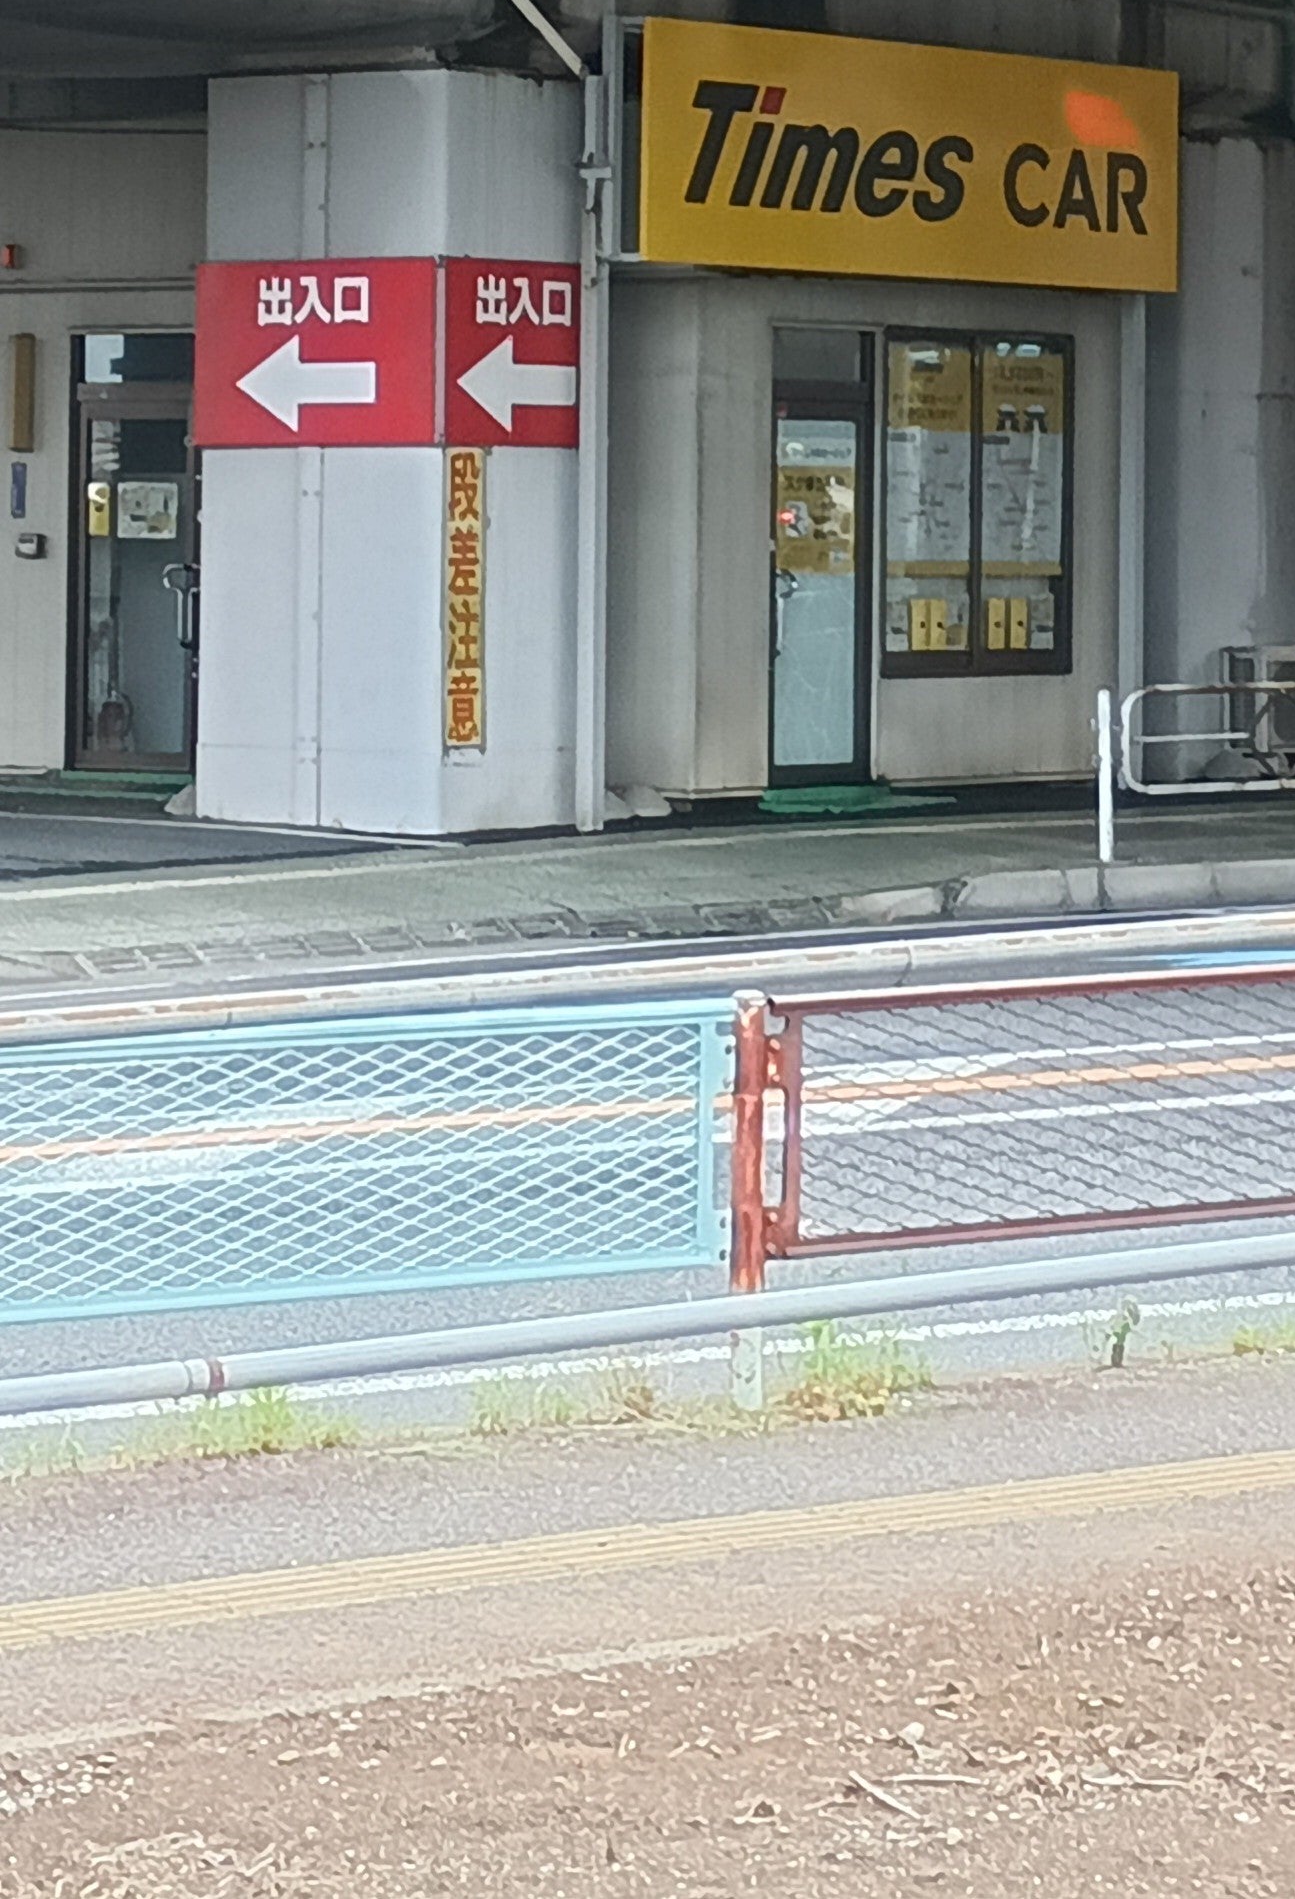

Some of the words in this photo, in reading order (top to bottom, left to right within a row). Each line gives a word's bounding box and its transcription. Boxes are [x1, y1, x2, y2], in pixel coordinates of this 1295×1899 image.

[685, 80, 974, 222] Times
[1003, 143, 1148, 235] CAR
[257, 276, 369, 326] 出入口
[475, 274, 572, 327] 出入口
[447, 451, 480, 743] 段差注意
